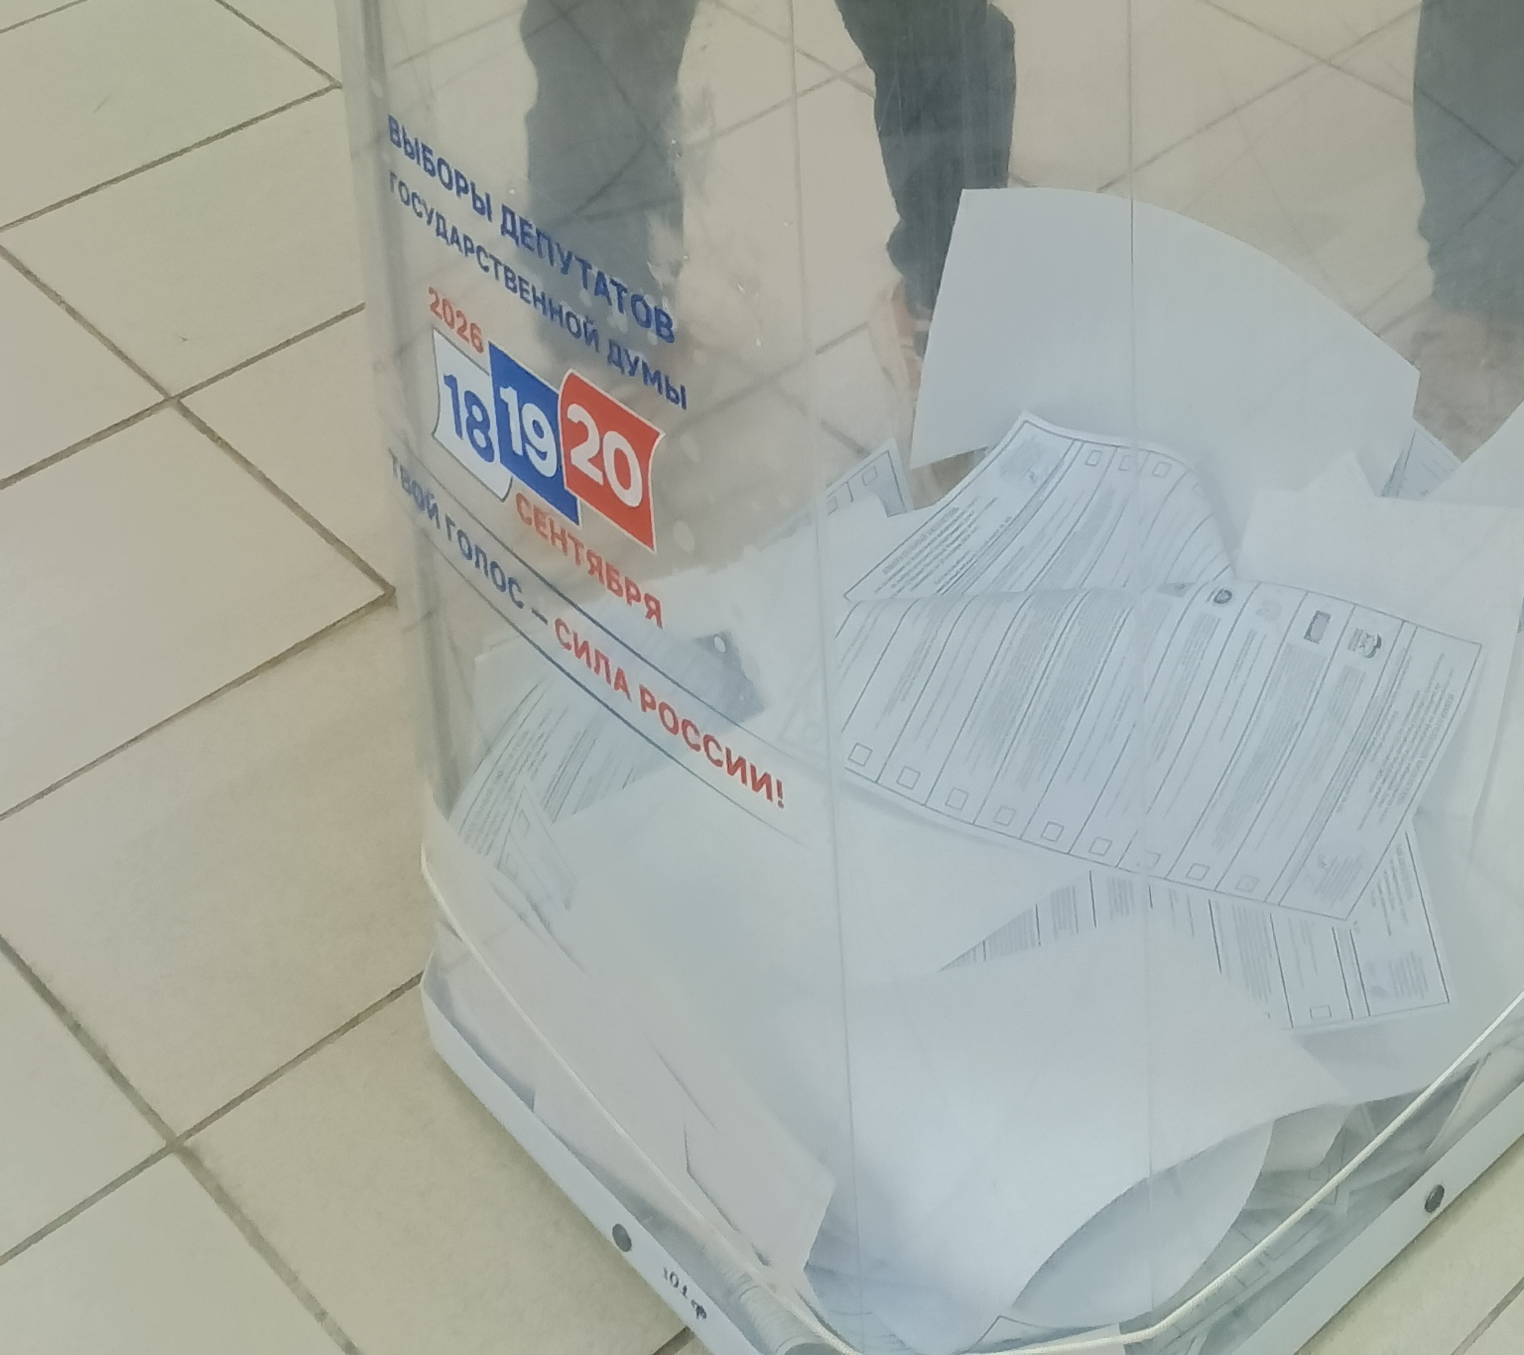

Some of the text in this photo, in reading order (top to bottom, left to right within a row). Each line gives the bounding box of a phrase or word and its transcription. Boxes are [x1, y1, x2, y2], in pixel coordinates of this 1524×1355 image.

[387, 114, 676, 345] ВЫБОРЫ ДЕПУТАТОВ
[389, 171, 688, 411] ГОСУДАРСТВЕННОЙ ДУМЫ
[428, 286, 485, 354] 2026
[443, 373, 644, 508] 18 19 20
[391, 452, 442, 532] ТВОЙ
[445, 516, 525, 610] ГОЛОС
[554, 617, 632, 700] СИЛА
[639, 683, 785, 809] РОССИИ!
[515, 491, 664, 629] СЕНТЯБРЯ
